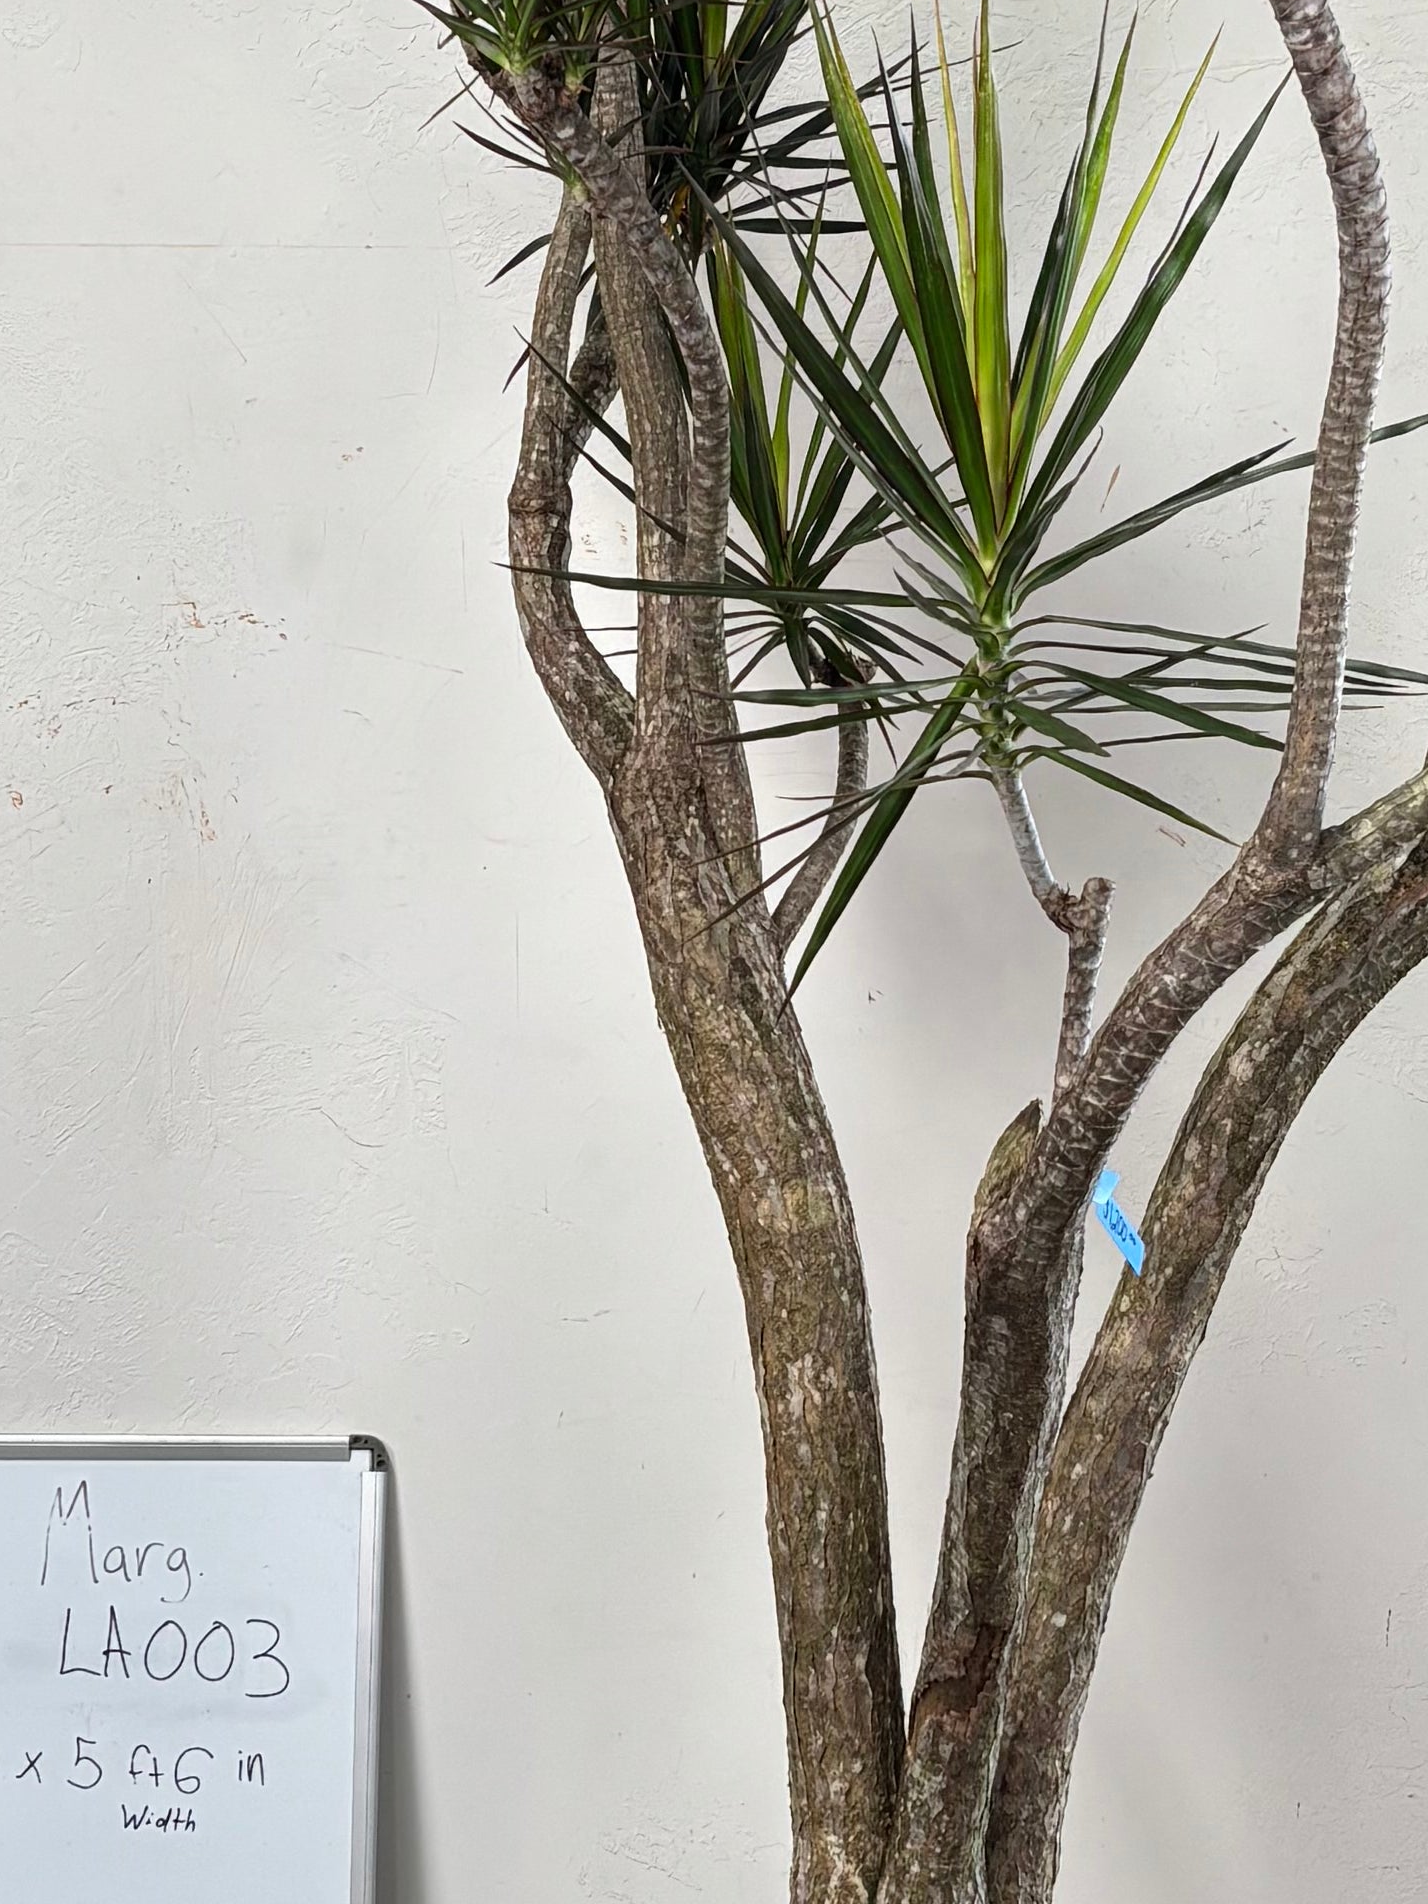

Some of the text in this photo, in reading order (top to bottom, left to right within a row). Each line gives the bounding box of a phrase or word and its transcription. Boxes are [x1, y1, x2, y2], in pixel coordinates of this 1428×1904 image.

[40, 1479, 204, 1604] Marg.
[59, 1604, 290, 1698] LA003
[66, 1735, 103, 1790] 5
[237, 1749, 266, 1787] in
[120, 1803, 197, 1834] Width
